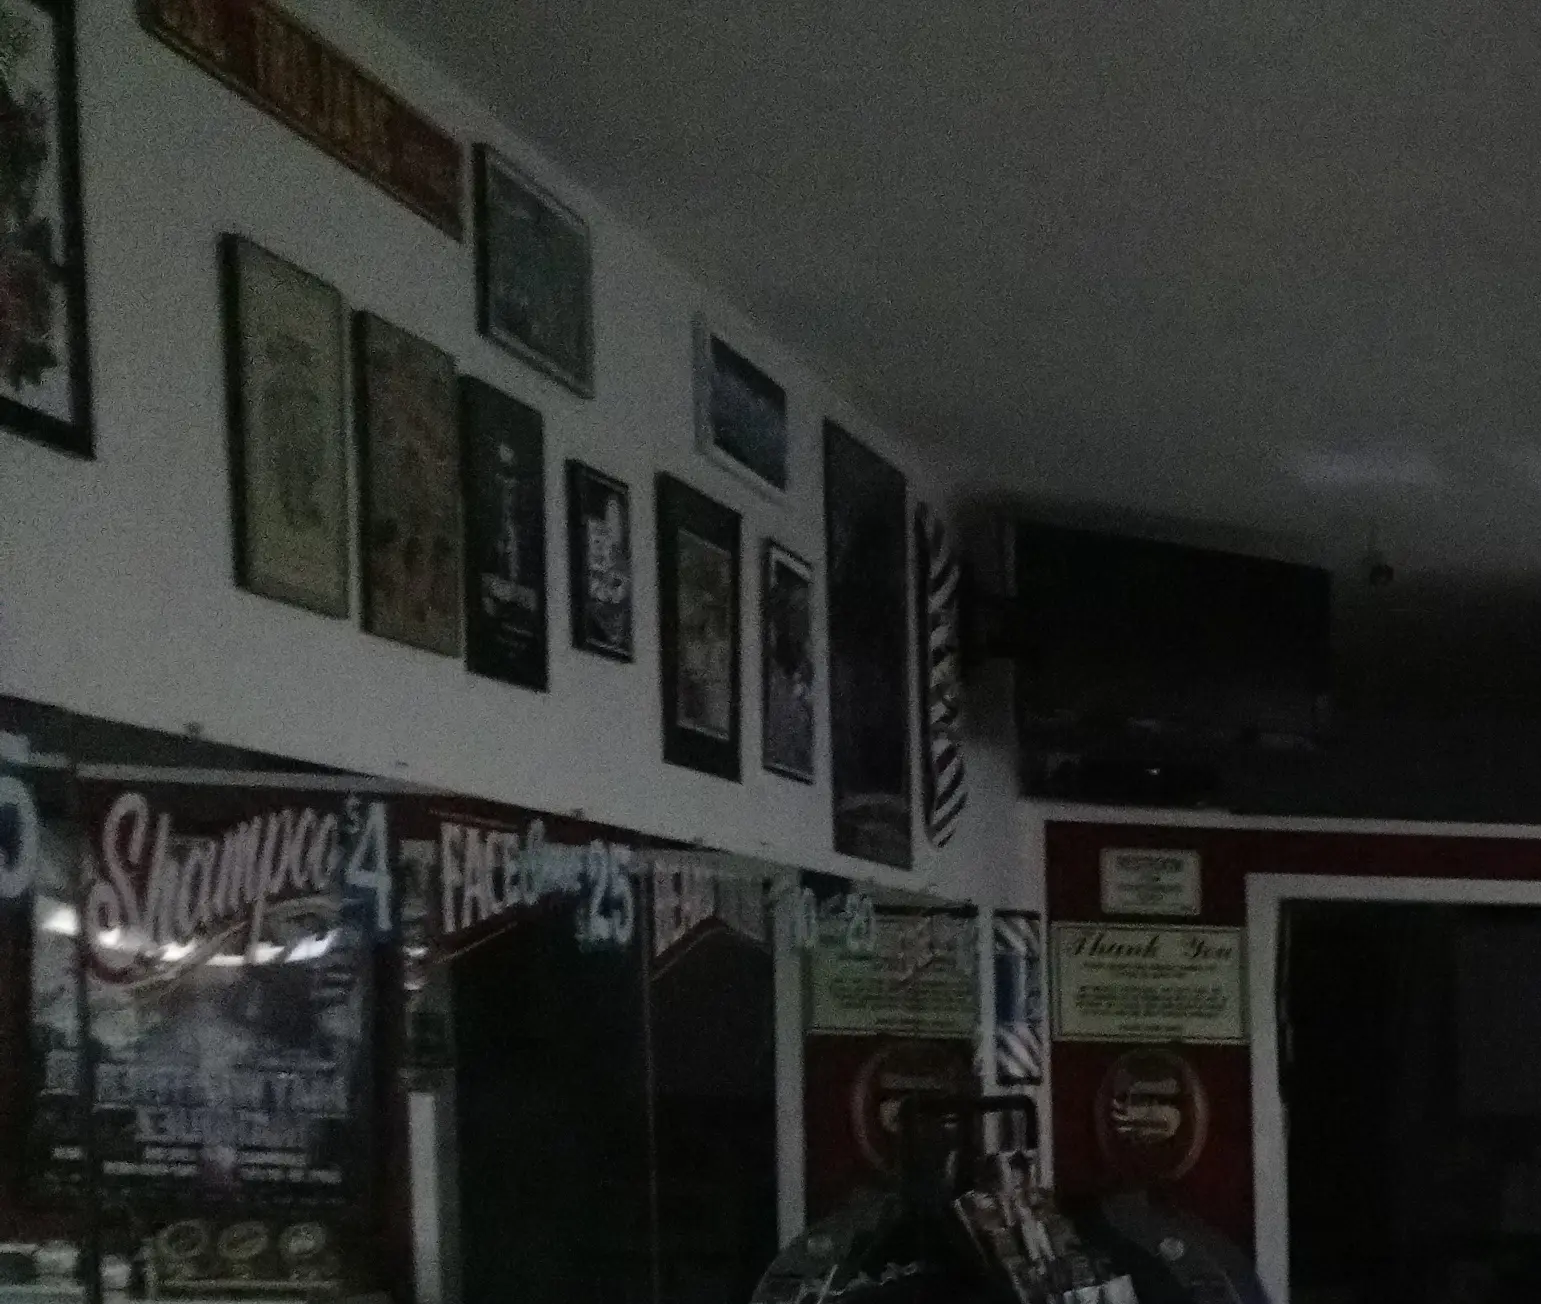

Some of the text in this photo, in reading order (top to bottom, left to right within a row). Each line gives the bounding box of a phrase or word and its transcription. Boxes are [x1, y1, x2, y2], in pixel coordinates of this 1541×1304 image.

[88, 790, 342, 968] Shampoo
[440, 820, 520, 934] FACE
[1065, 929, 1236, 960] Thank You
